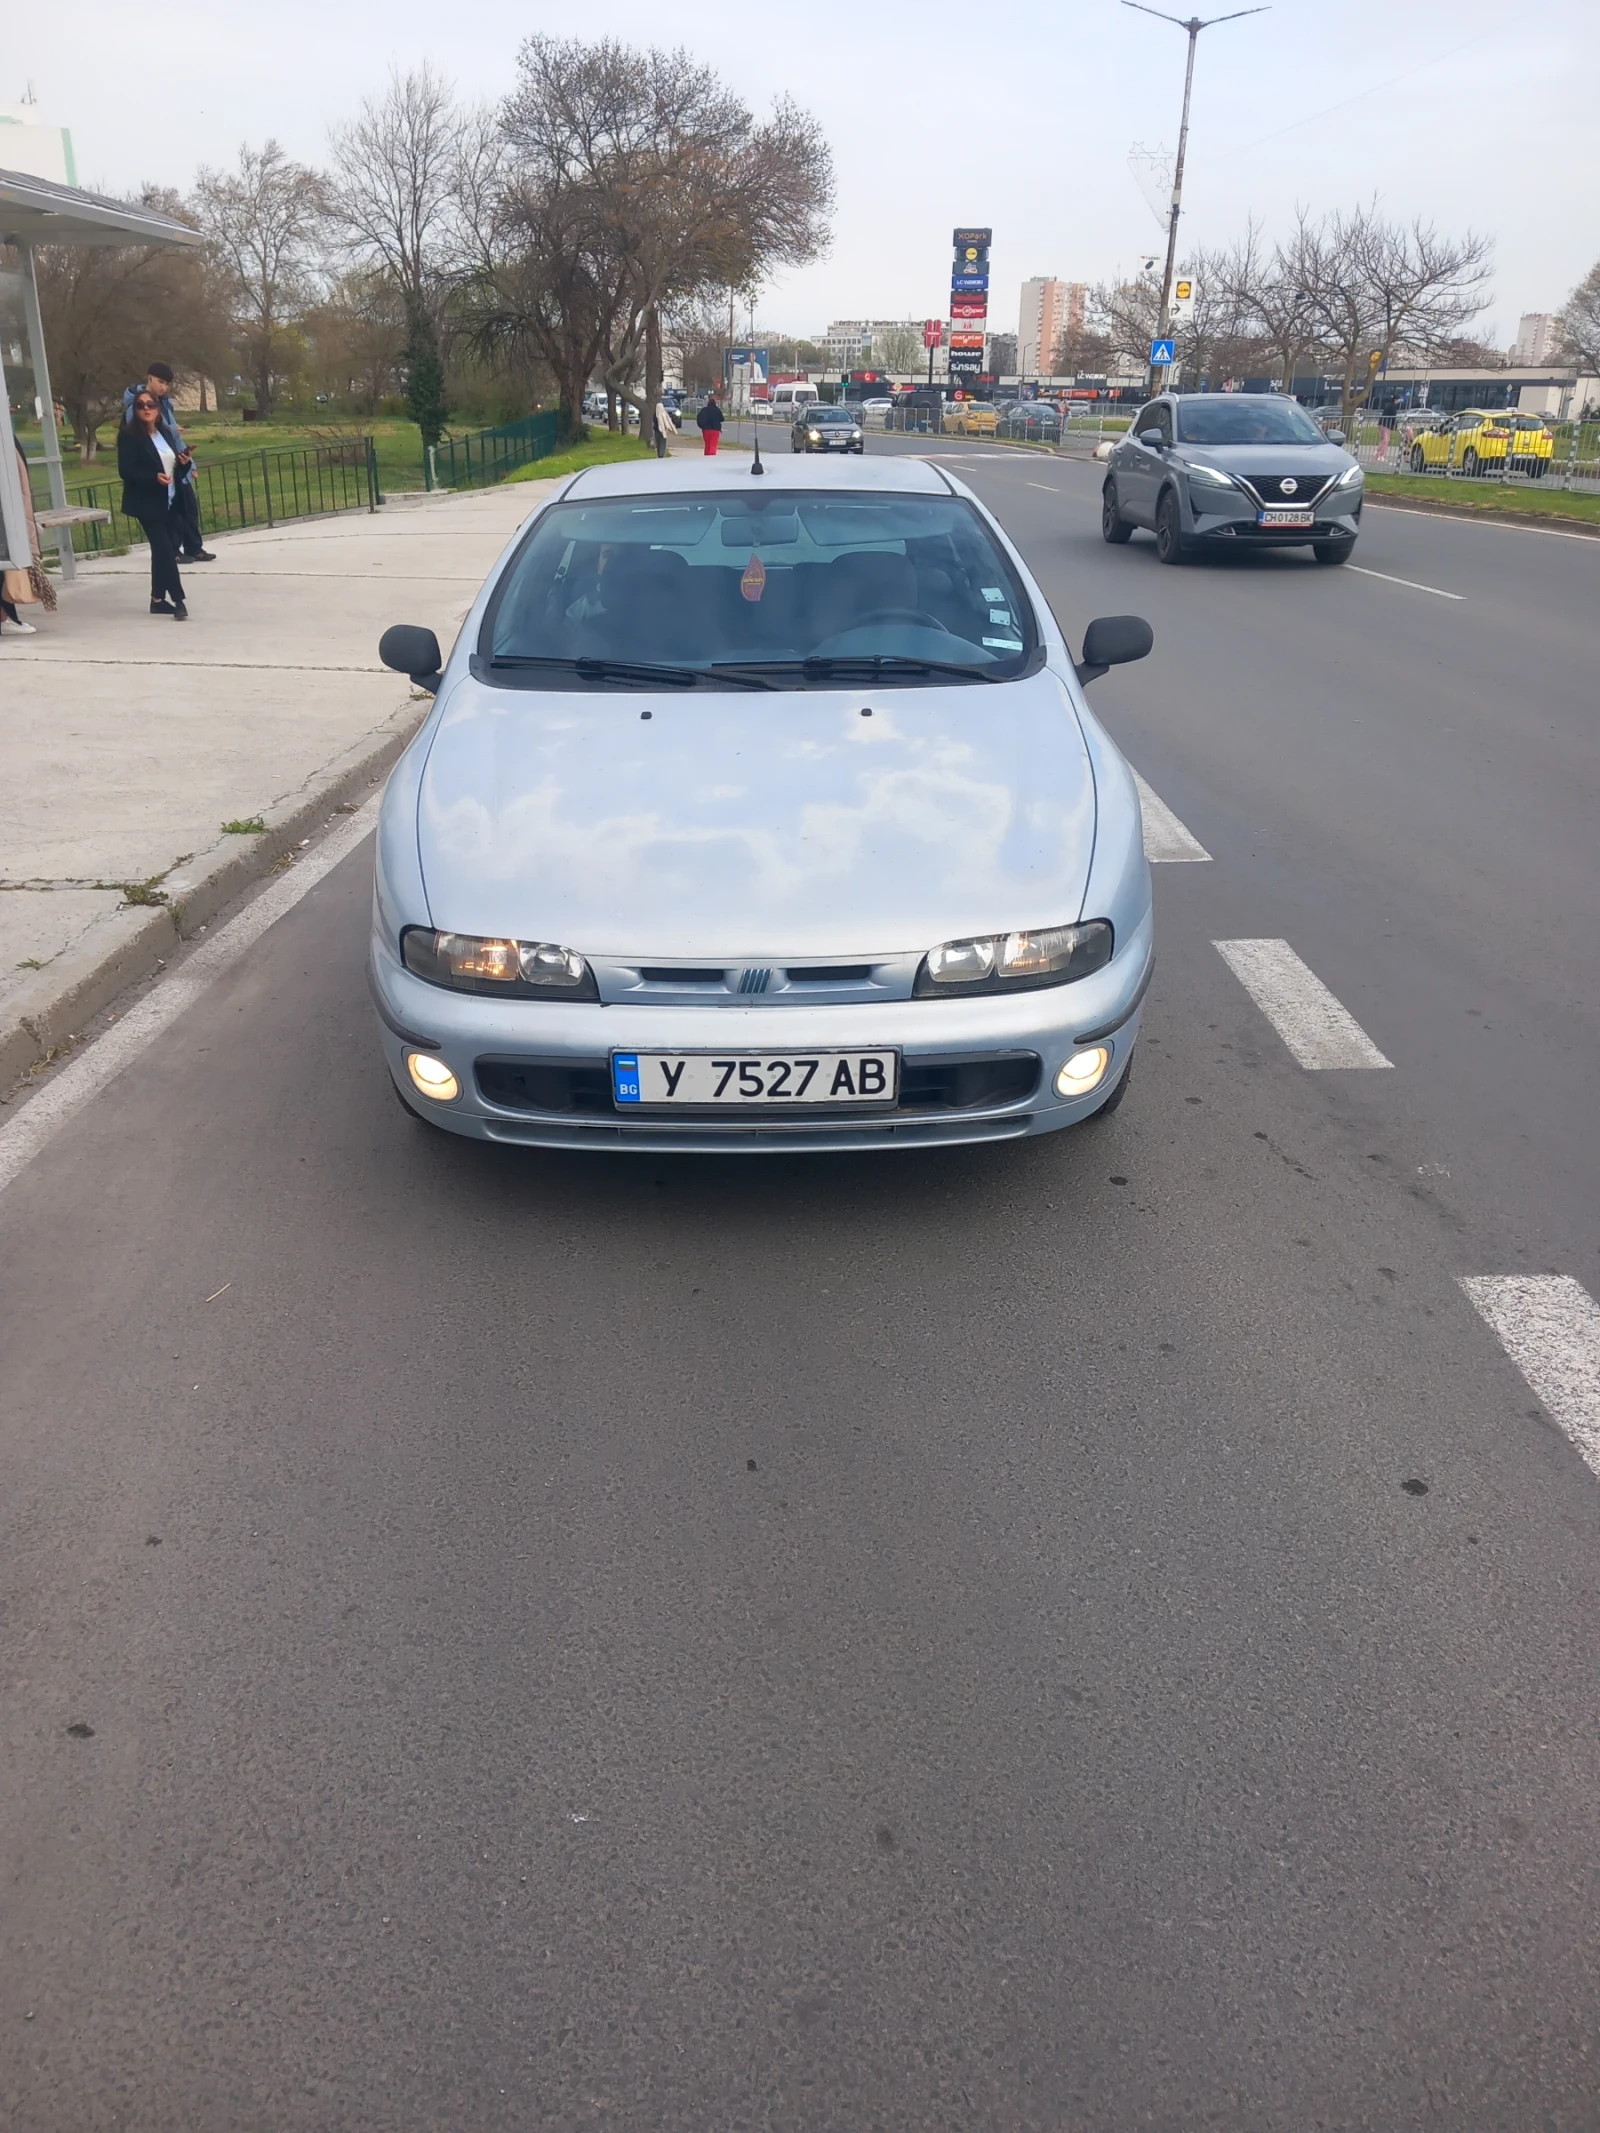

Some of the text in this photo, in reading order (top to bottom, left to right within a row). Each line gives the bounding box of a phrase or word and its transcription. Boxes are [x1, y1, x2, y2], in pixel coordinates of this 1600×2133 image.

[950, 361, 981, 373] sinsay
[711, 1060, 820, 1098] 7527
[829, 1058, 887, 1096] AB
[619, 1084, 638, 1096] BG
